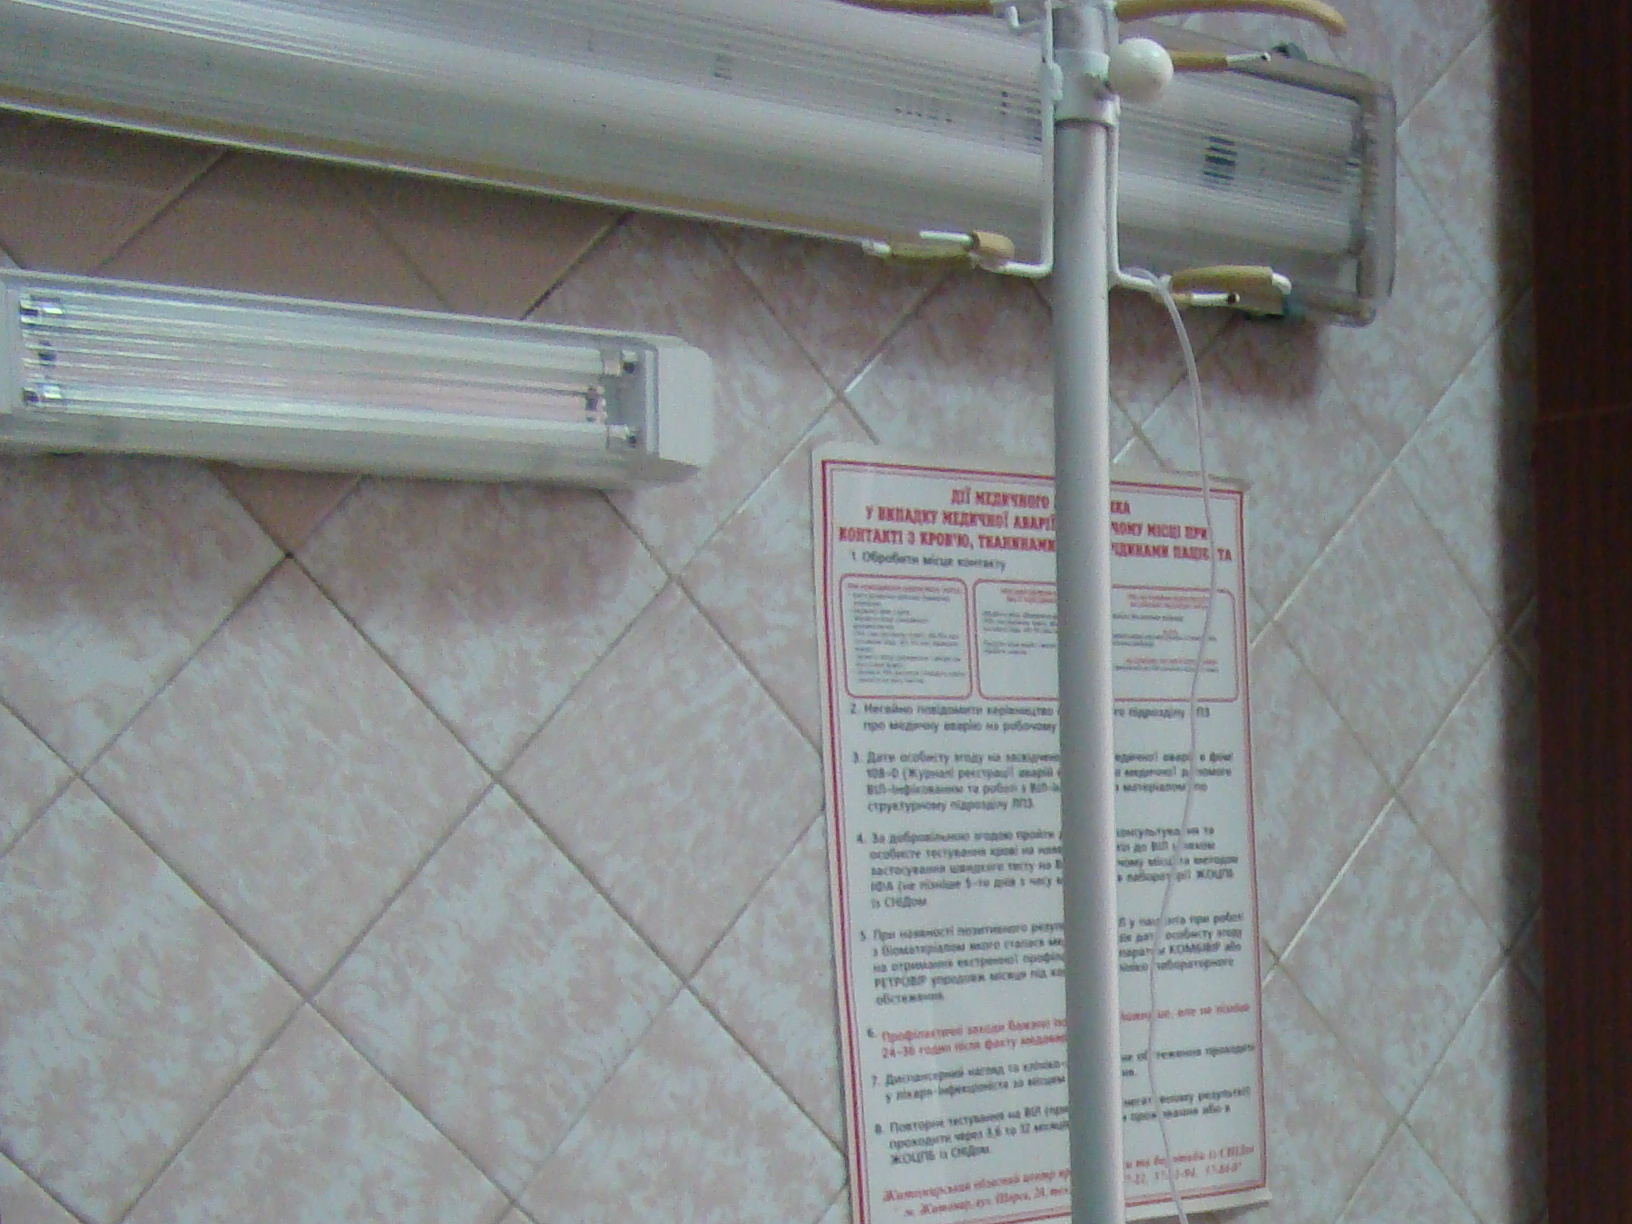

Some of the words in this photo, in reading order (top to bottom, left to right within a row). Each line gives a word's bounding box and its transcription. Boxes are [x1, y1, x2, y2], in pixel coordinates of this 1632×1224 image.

[975, 491, 1050, 509] МЕДИЧНОГО
[865, 505, 873, 520] У
[878, 506, 938, 525] ВИПАДКУ
[839, 527, 903, 545] КОНТАКТІ
